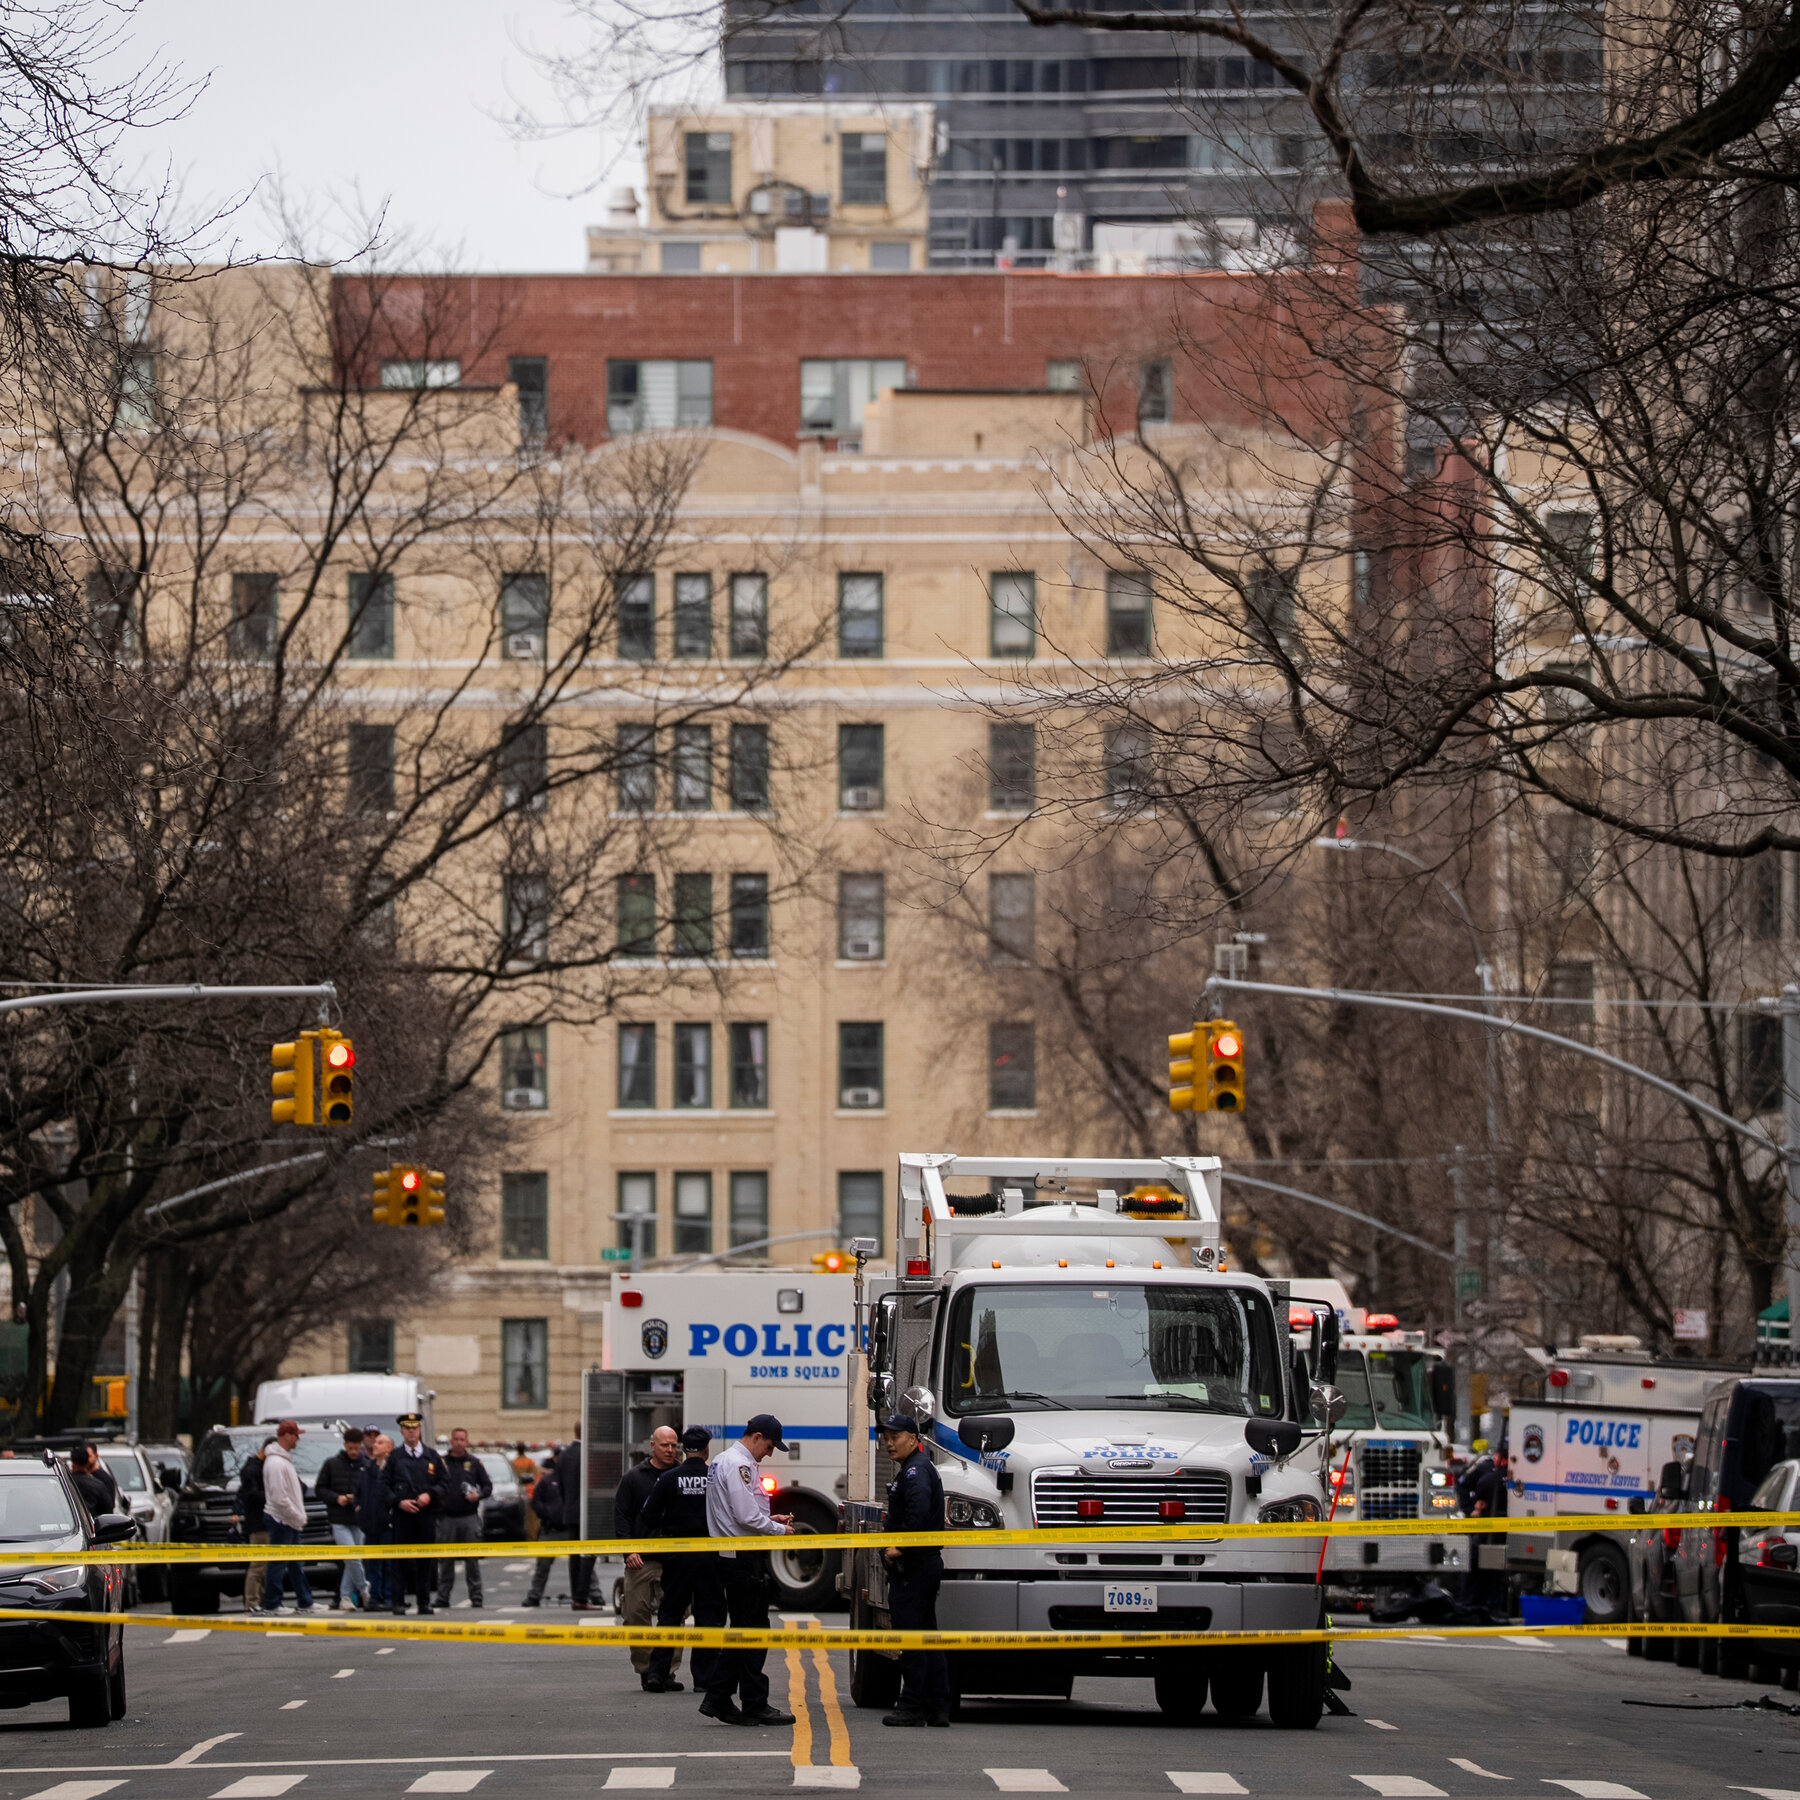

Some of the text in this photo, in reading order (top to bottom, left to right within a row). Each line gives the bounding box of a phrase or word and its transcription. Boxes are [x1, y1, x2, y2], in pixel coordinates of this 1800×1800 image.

[750, 1366, 840, 1380] BOMB SQUAD
[1565, 1419, 1641, 1448] POLICE
[1083, 1451, 1178, 1459] POLICE
[678, 1476, 708, 1488] NYPD
[1564, 1471, 1640, 1488] EMERGENCY SERVICE
[1108, 1592, 1141, 1606] 7089
